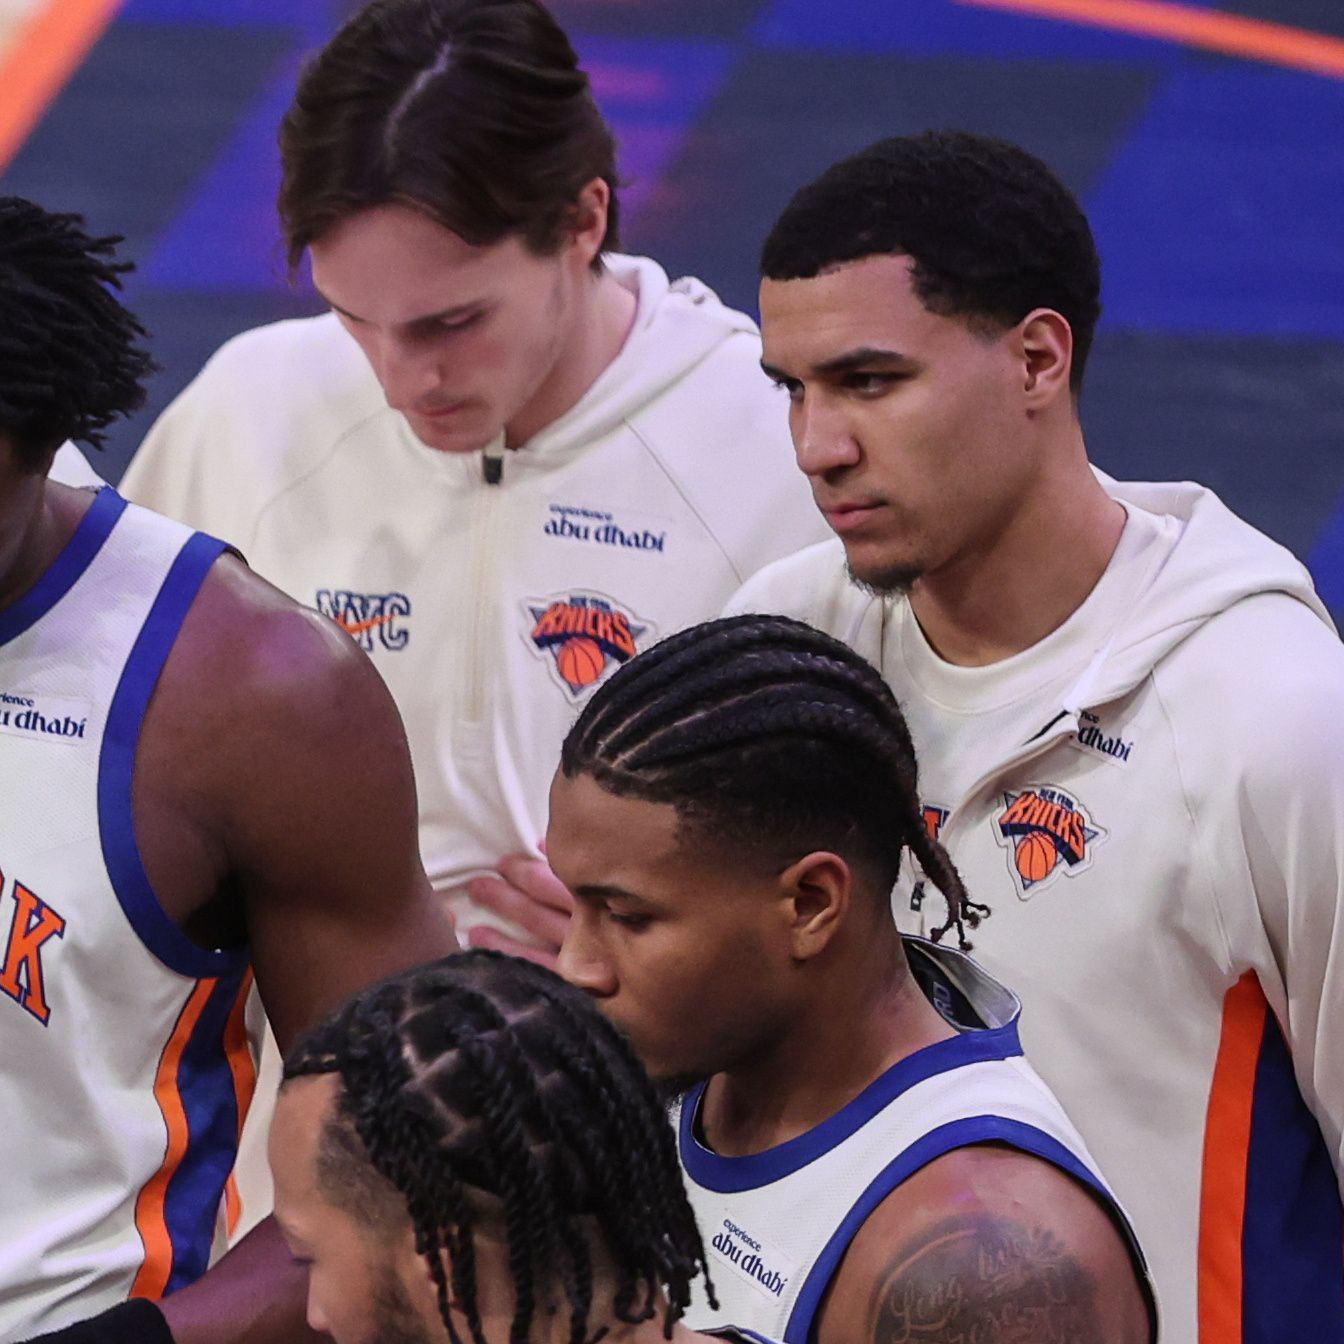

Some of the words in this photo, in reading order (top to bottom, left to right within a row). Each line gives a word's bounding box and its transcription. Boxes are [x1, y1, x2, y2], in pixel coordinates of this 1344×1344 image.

[544, 516, 589, 540] abu
[594, 524, 666, 552] dhabi
[14, 709, 88, 739] dhabi
[998, 790, 1085, 860] KNICKS
[712, 1232, 743, 1264] abu
[741, 1254, 788, 1297] dhabi
